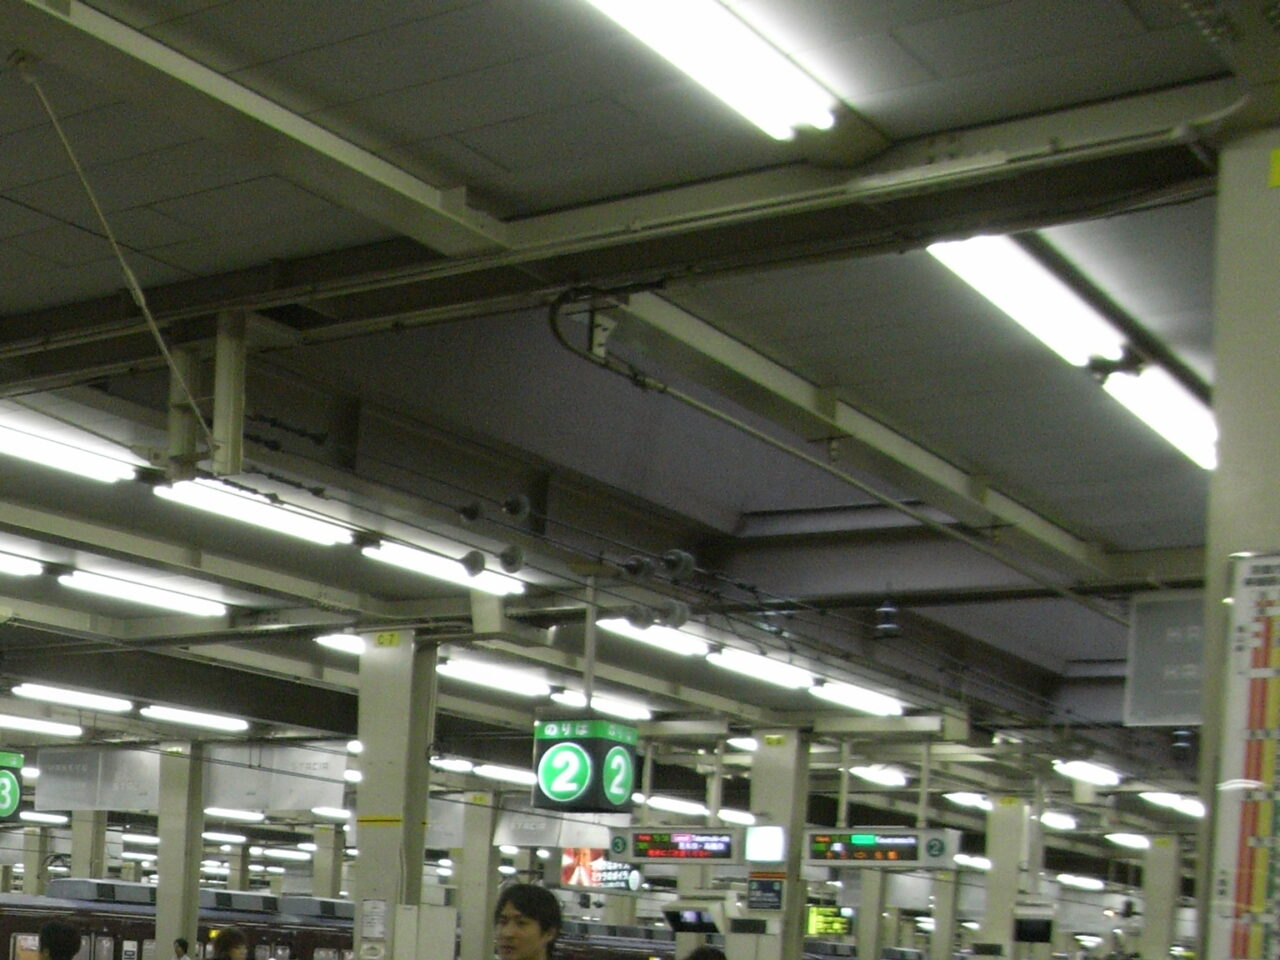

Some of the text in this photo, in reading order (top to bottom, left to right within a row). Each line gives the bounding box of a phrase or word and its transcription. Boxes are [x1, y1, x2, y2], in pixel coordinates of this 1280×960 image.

[544, 723, 588, 736] のりば
[551, 751, 579, 791] 2
[611, 755, 625, 794] 2
[930, 841, 941, 855] 2
